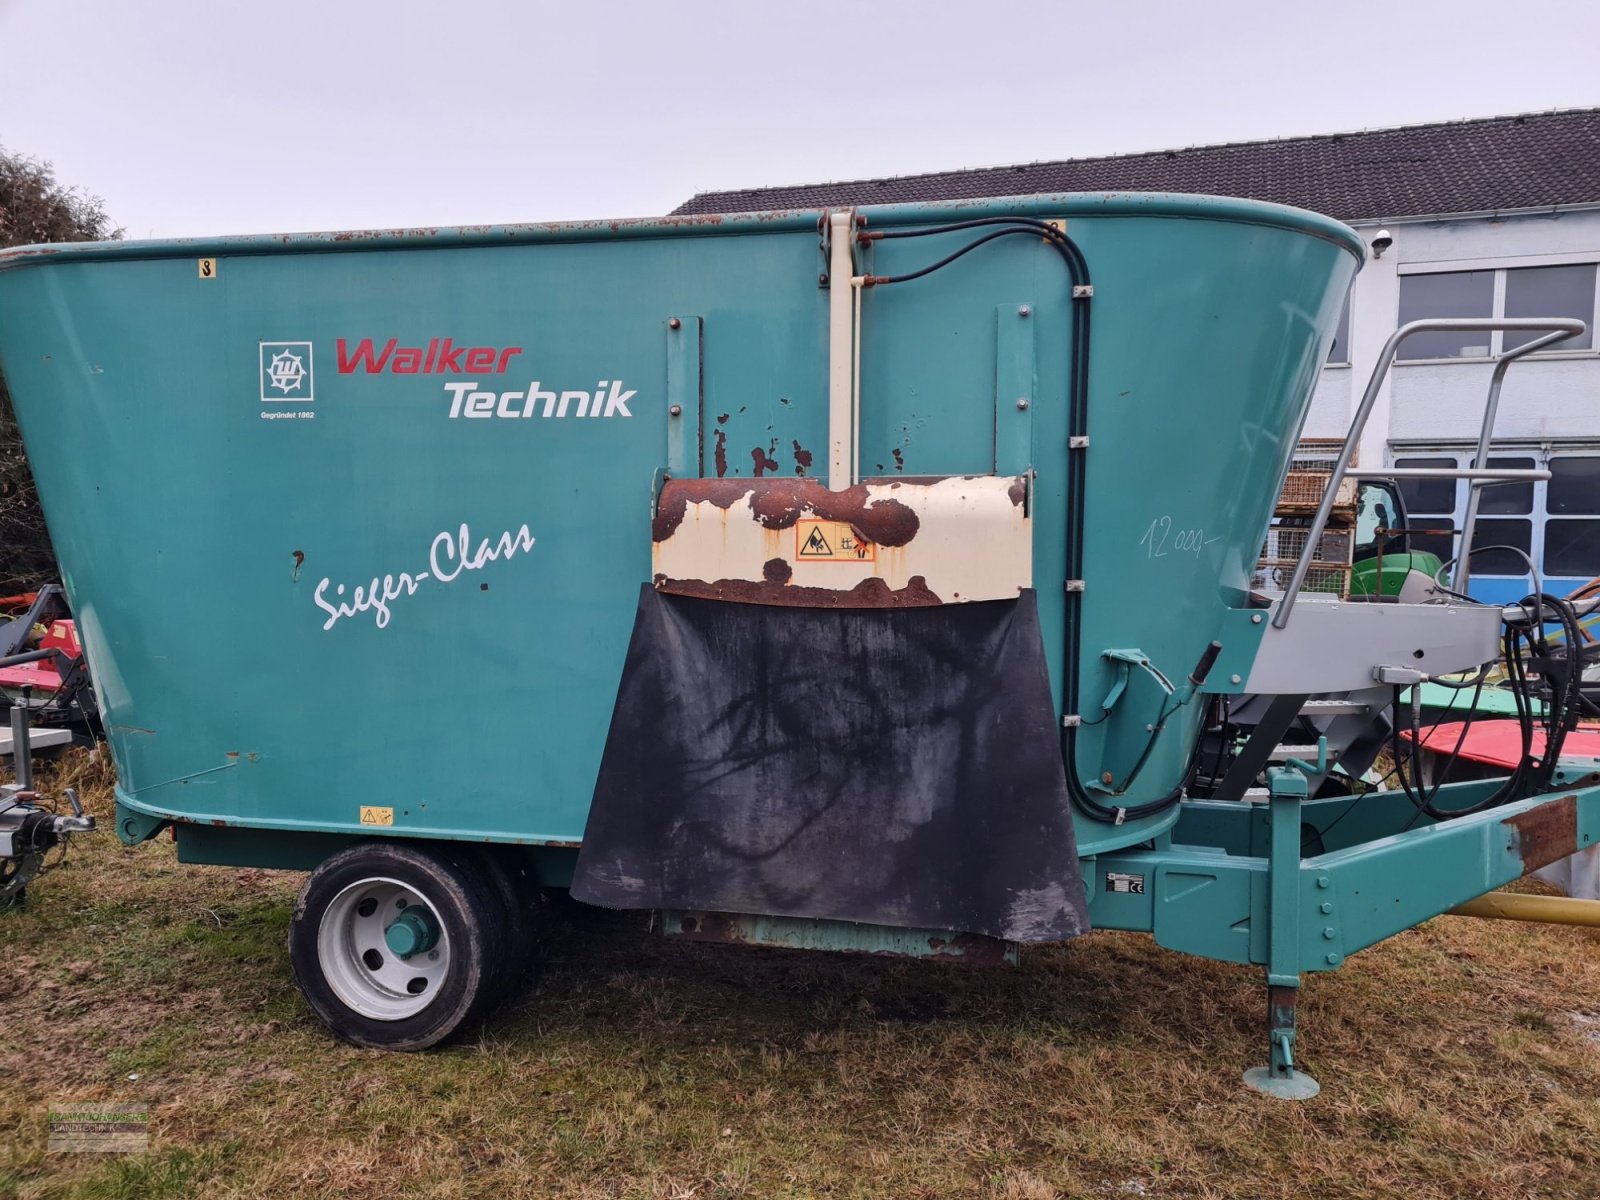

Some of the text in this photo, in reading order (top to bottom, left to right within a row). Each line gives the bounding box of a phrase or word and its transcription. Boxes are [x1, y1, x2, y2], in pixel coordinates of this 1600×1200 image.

[336, 338, 522, 374] Walker
[261, 411, 296, 420] Gegründet
[444, 380, 637, 418] Technik
[314, 523, 536, 631] Sieger-Class
